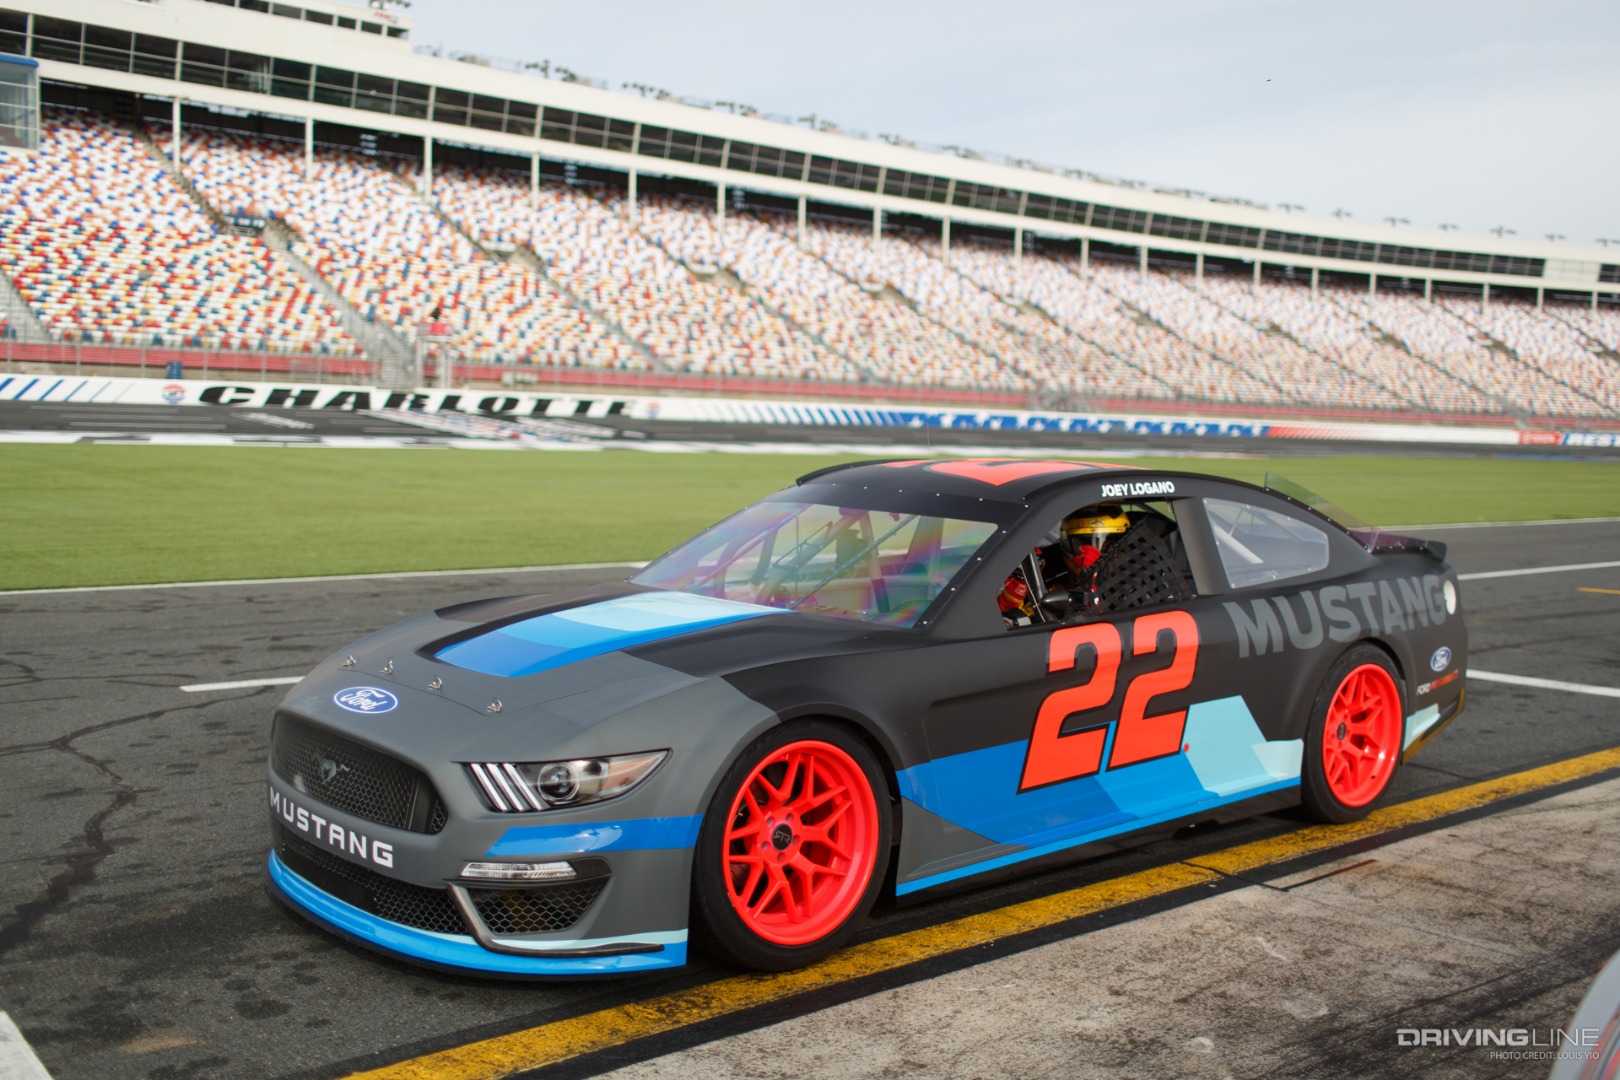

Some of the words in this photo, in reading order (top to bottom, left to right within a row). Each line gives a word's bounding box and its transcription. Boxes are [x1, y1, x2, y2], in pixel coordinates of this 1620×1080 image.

[199, 385, 635, 416] CHARLOTTE
[1101, 484, 1129, 497] JOEY
[1130, 481, 1175, 495] LOGANO
[1222, 574, 1446, 658] MUSTANG
[340, 689, 388, 710] Ford
[1020, 610, 1199, 792] 22
[270, 786, 393, 868] MUSTANG
